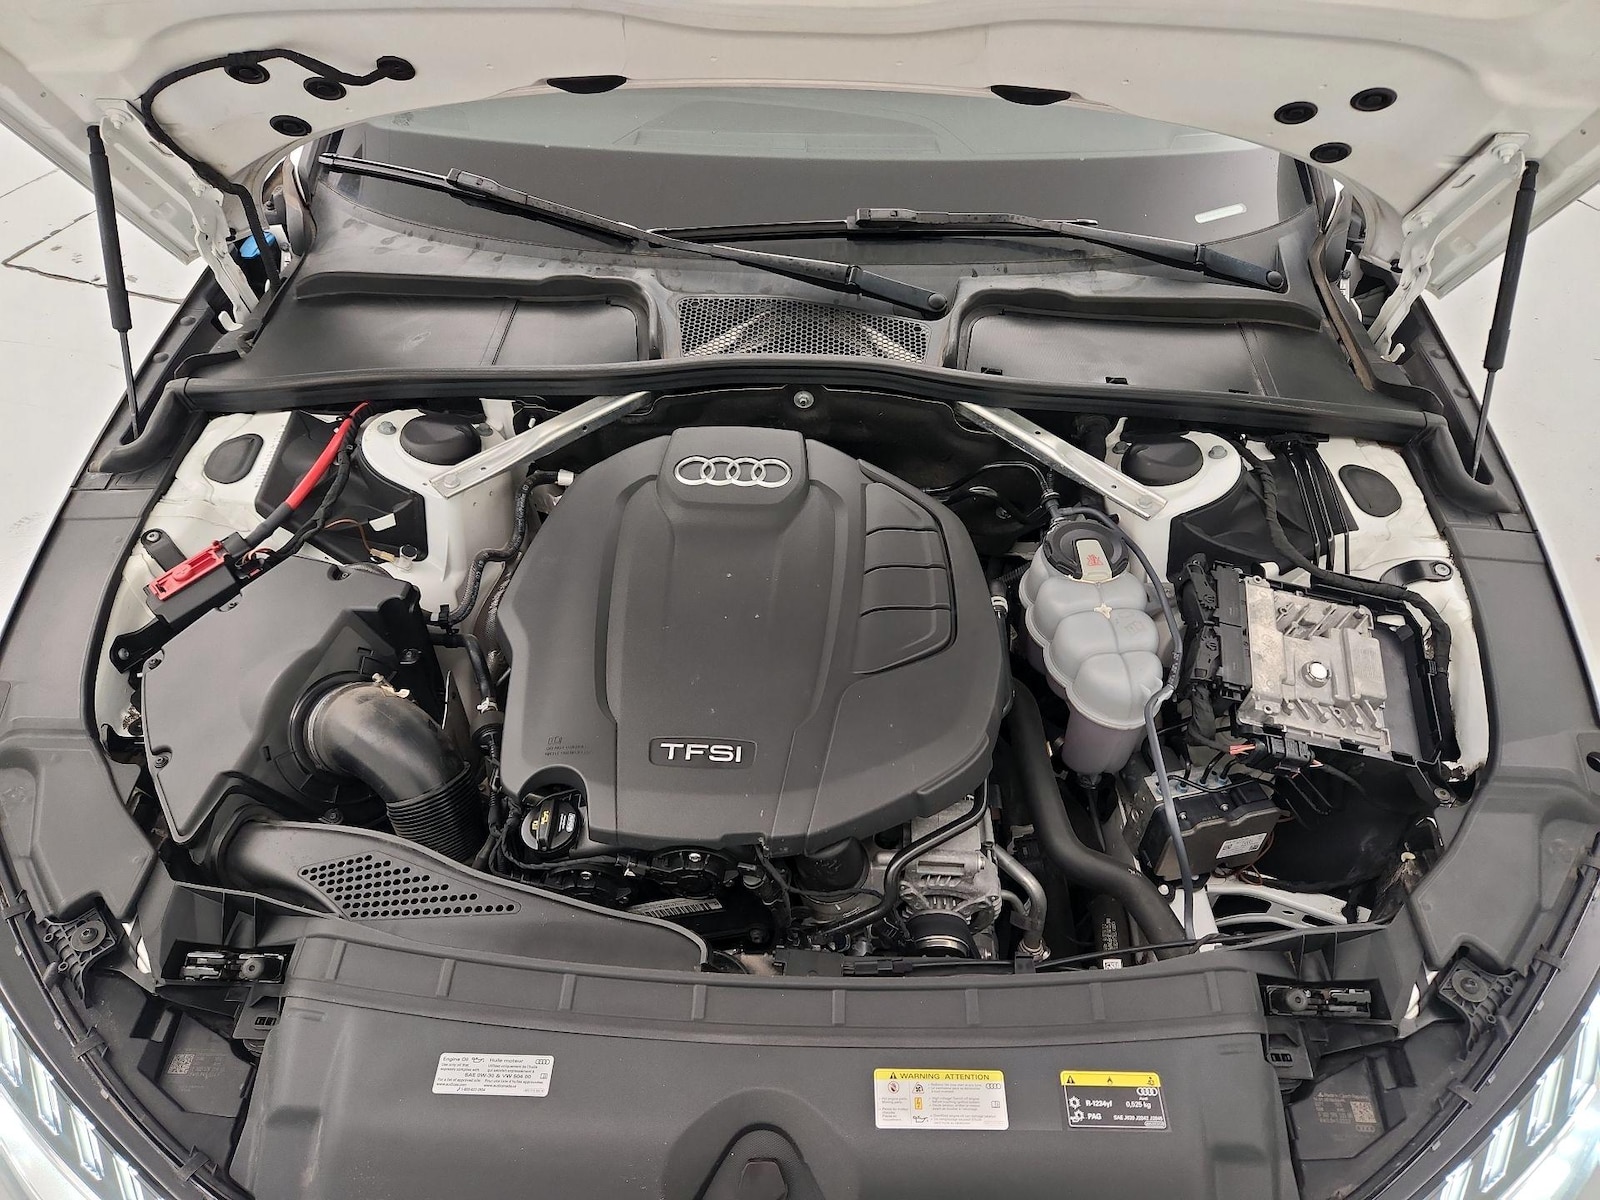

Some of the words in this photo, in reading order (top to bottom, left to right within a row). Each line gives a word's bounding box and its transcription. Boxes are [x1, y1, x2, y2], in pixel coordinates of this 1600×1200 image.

[660, 743, 742, 763] TFSI
[899, 1072, 940, 1080] WARNING
[944, 1073, 990, 1081] ATTENTION
[1085, 1099, 1112, 1108] R-1234yf
[1143, 1101, 1152, 1109] kg
